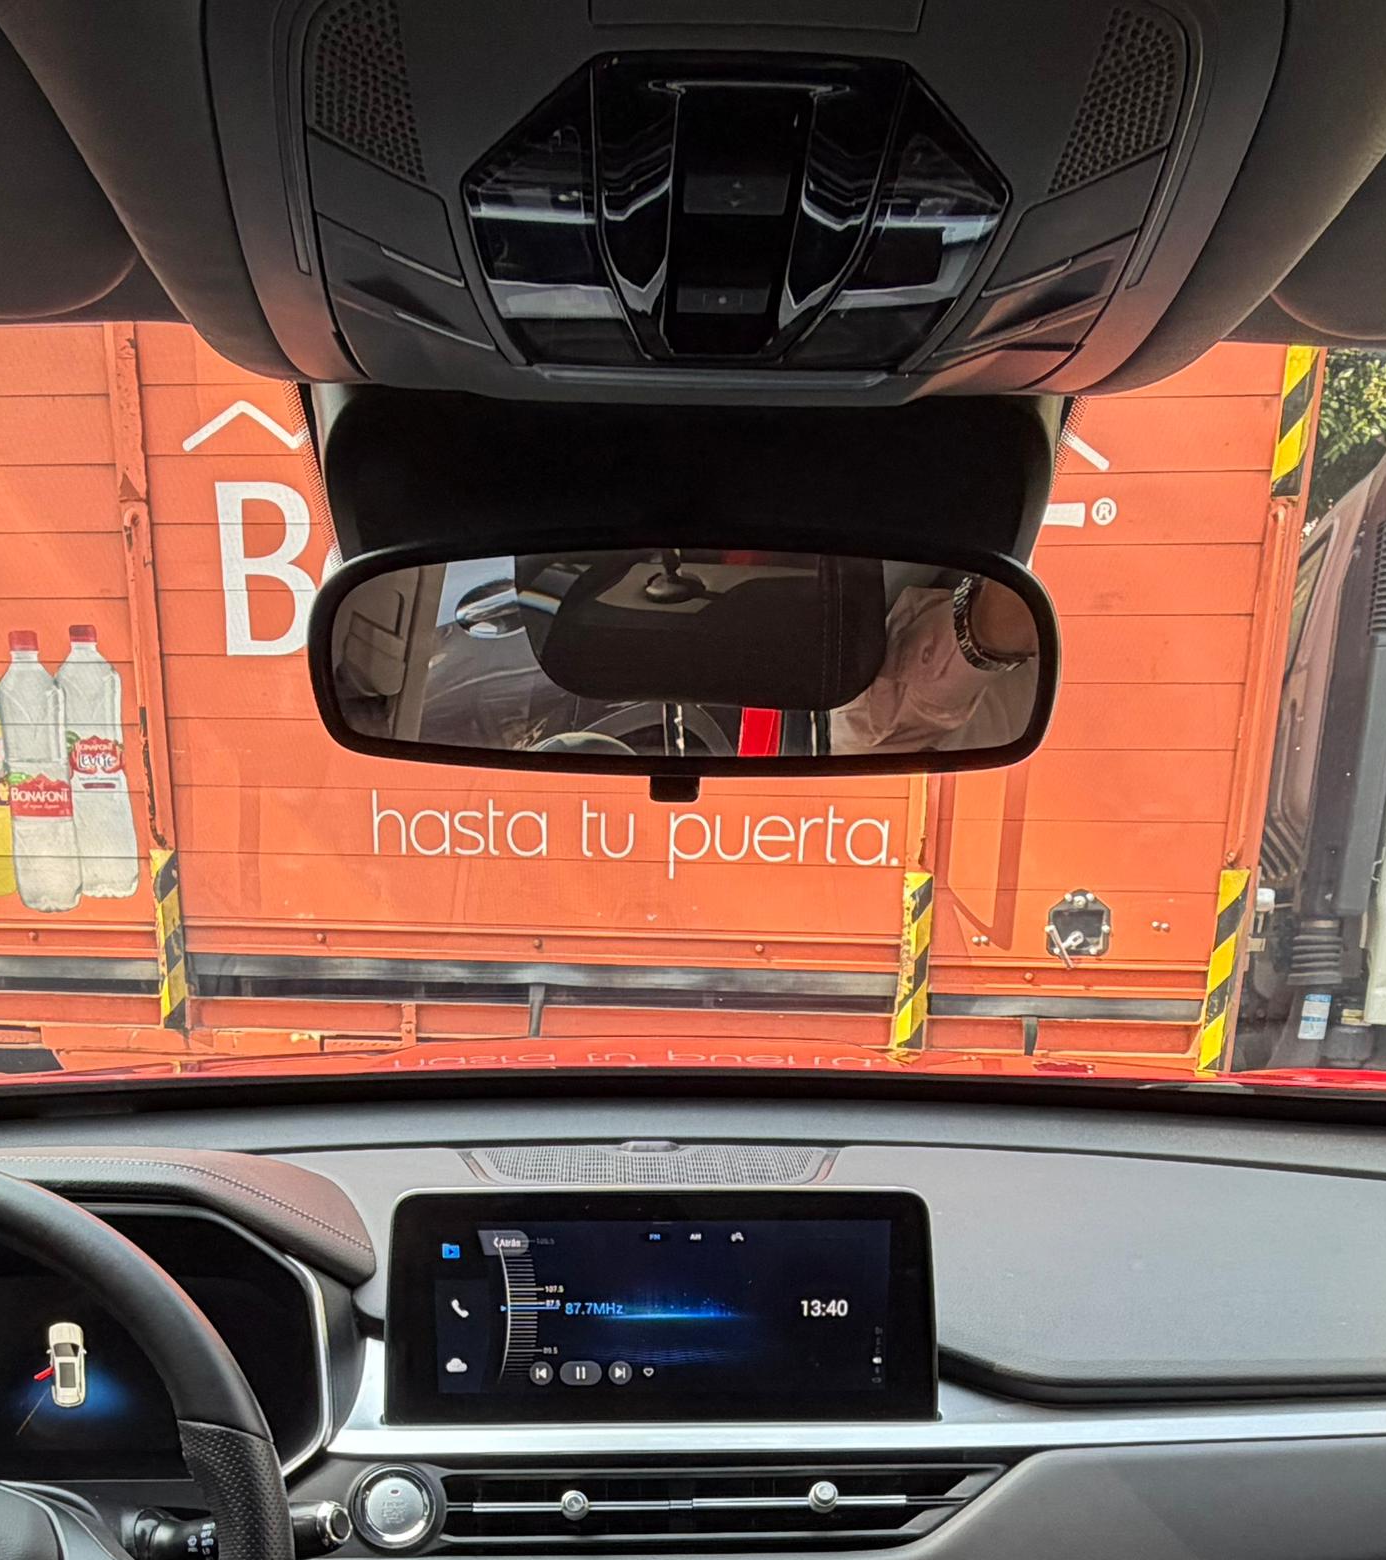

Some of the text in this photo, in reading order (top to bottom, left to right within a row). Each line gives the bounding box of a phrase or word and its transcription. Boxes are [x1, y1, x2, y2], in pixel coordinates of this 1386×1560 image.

[11, 787, 70, 802] BONAFONT
[372, 789, 900, 880] hasta tu puerta.
[565, 1301, 624, 1316] 87.7MHz
[800, 1299, 849, 1318] 13:40
